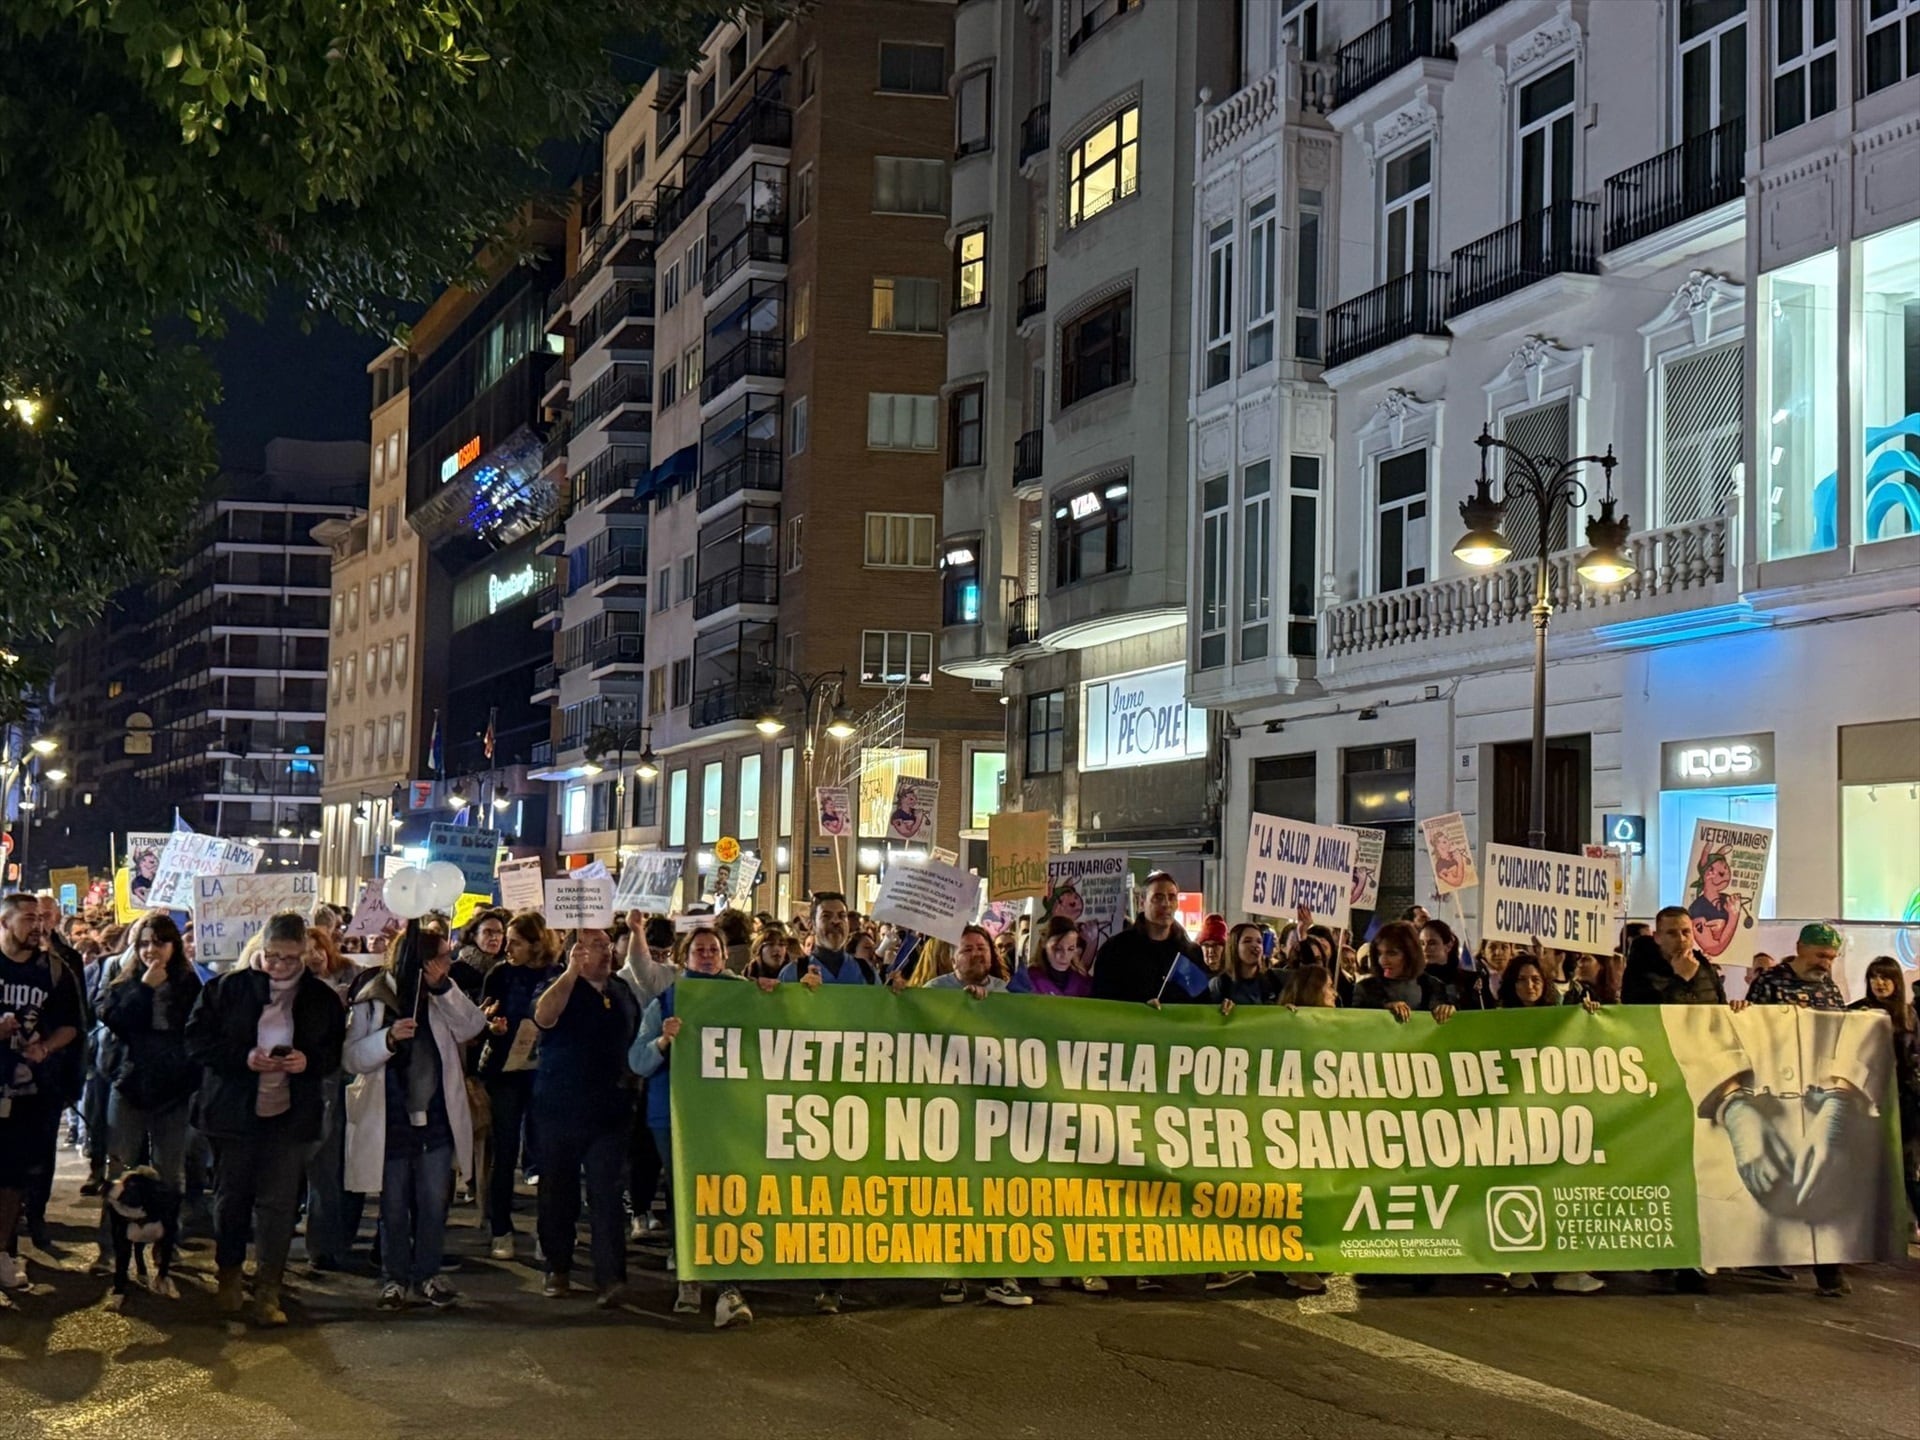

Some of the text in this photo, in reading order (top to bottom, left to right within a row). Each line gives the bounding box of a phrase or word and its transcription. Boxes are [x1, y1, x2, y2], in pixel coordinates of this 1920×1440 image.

[1112, 687, 1143, 714] Inmo
[1118, 704, 1182, 754] PEOPLE
[1680, 746, 1752, 777] IQOS
[1277, 829, 1310, 865] SALUD
[1313, 835, 1351, 873] ANIMAL
[1700, 826, 1768, 849] VETERINARI@S
[1048, 858, 1122, 877] ETERINARI@S
[202, 878, 224, 897] LA
[293, 877, 316, 893] DEL
[1253, 871, 1267, 904] ES
[1271, 874, 1286, 906] UN
[1556, 864, 1571, 895] DE
[1576, 866, 1609, 907] ELLOS,
[201, 922, 226, 937] ME
[1495, 899, 1557, 938] CUIDAMOS
[1564, 909, 1579, 941] DE
[203, 943, 220, 956] EL
[701, 1027, 1657, 1099] EL VETERINARIO VELA POR LA SALUD DE TODOS,
[766, 1094, 1606, 1169] ESO NO PUEDE SER SANCIONADO.
[696, 1174, 1303, 1219] NO A LA ACTUAL NORMATIVA SOBRE
[1556, 1218, 1673, 1233] VETERINARIOS
[695, 1222, 1314, 1265] LOS MEDICAMENTOS VETERINARIOS.
[1340, 1247, 1463, 1258] VETERINARIA DE VALENCIA
[1400, 1238, 1461, 1248] EMPRESARIAL
